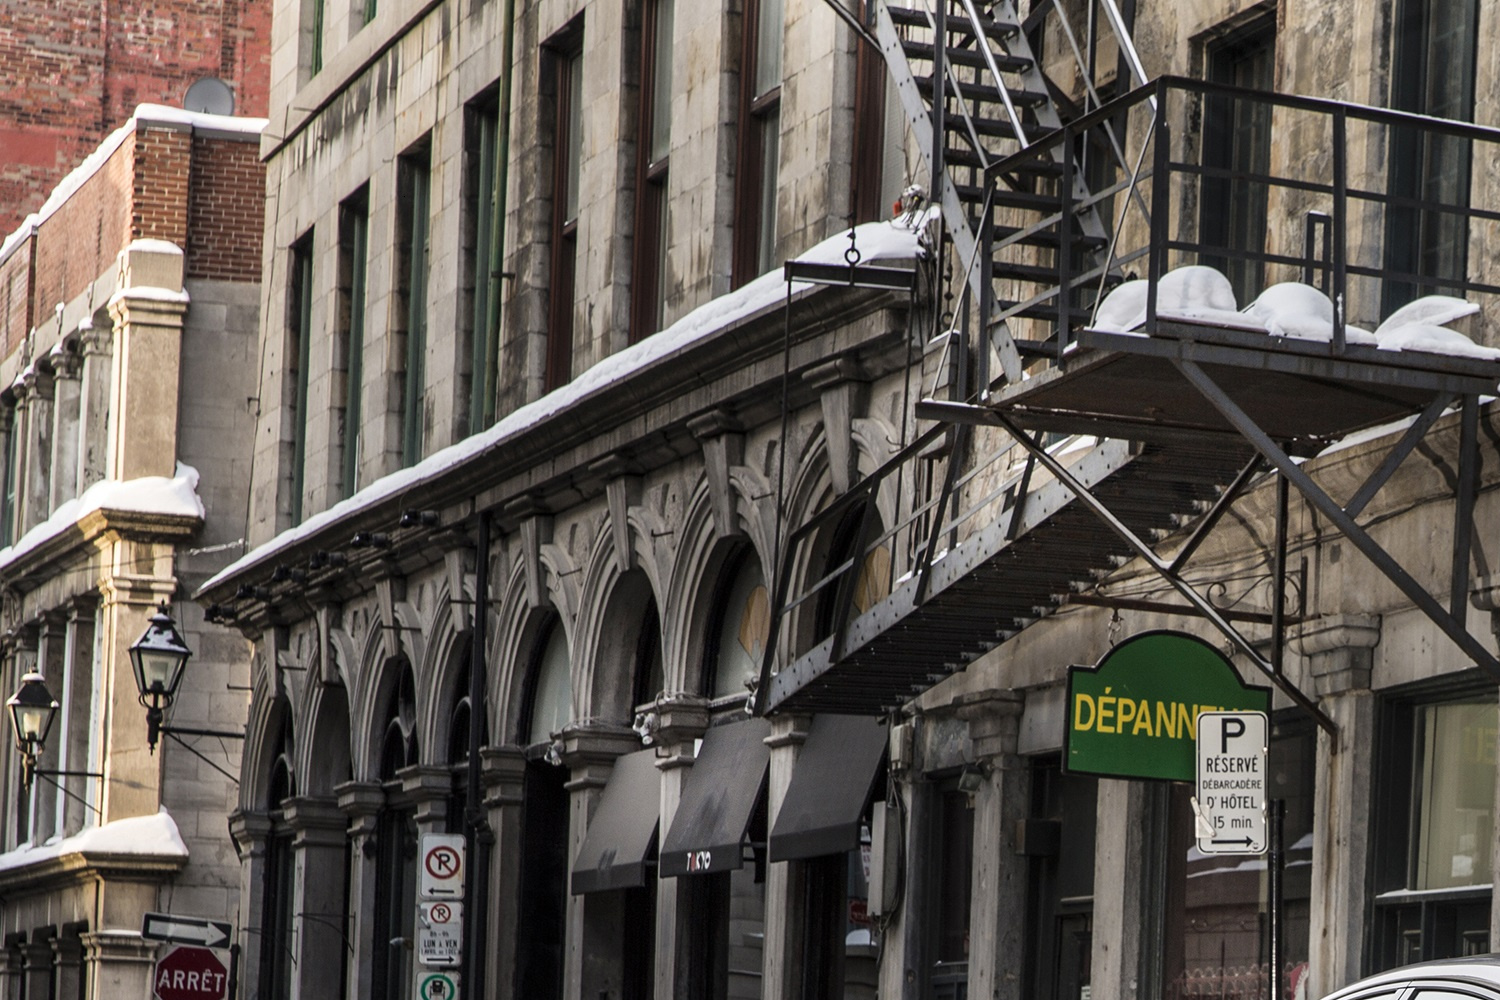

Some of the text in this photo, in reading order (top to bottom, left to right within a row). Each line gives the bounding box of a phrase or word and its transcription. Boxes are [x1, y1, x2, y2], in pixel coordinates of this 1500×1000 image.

[1074, 687, 1264, 741] DÉPANN
[1221, 718, 1246, 754] P
[1206, 755, 1259, 773] RÉSERVÉ
[1221, 794, 1258, 809] HÔTEL
[1213, 815, 1225, 829] 15
[159, 968, 225, 993] ARRÊT
